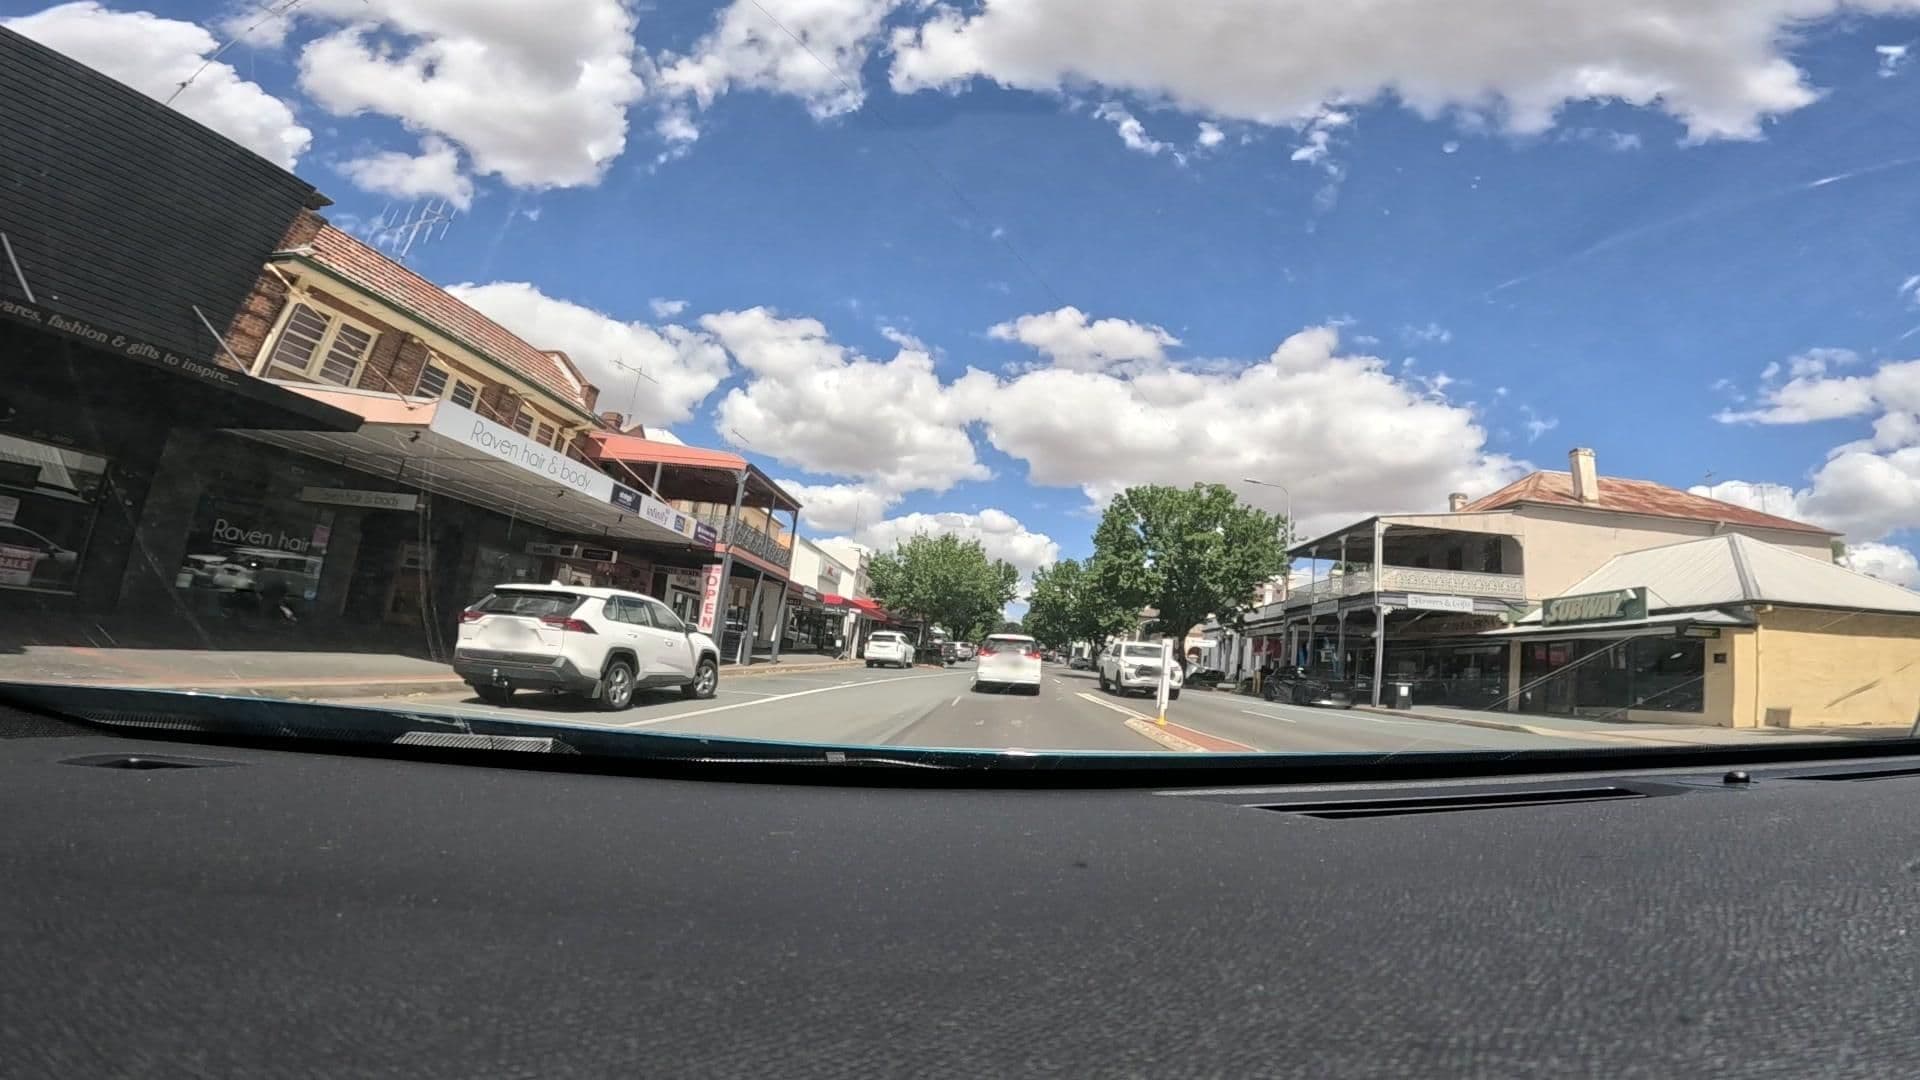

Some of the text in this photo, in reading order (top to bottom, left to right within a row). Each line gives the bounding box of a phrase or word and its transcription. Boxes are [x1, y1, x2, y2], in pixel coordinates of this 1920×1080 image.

[47, 314, 109, 344] fashion
[112, 334, 127, 348] &
[126, 342, 161, 361] gifts
[164, 352, 180, 367] to
[181, 358, 239, 387] inspire...
[470, 419, 592, 492] Raven hair & body
[213, 519, 310, 552] Raven hair
[702, 575, 718, 628] OPEN
[1545, 588, 1637, 624] SUBWAY
